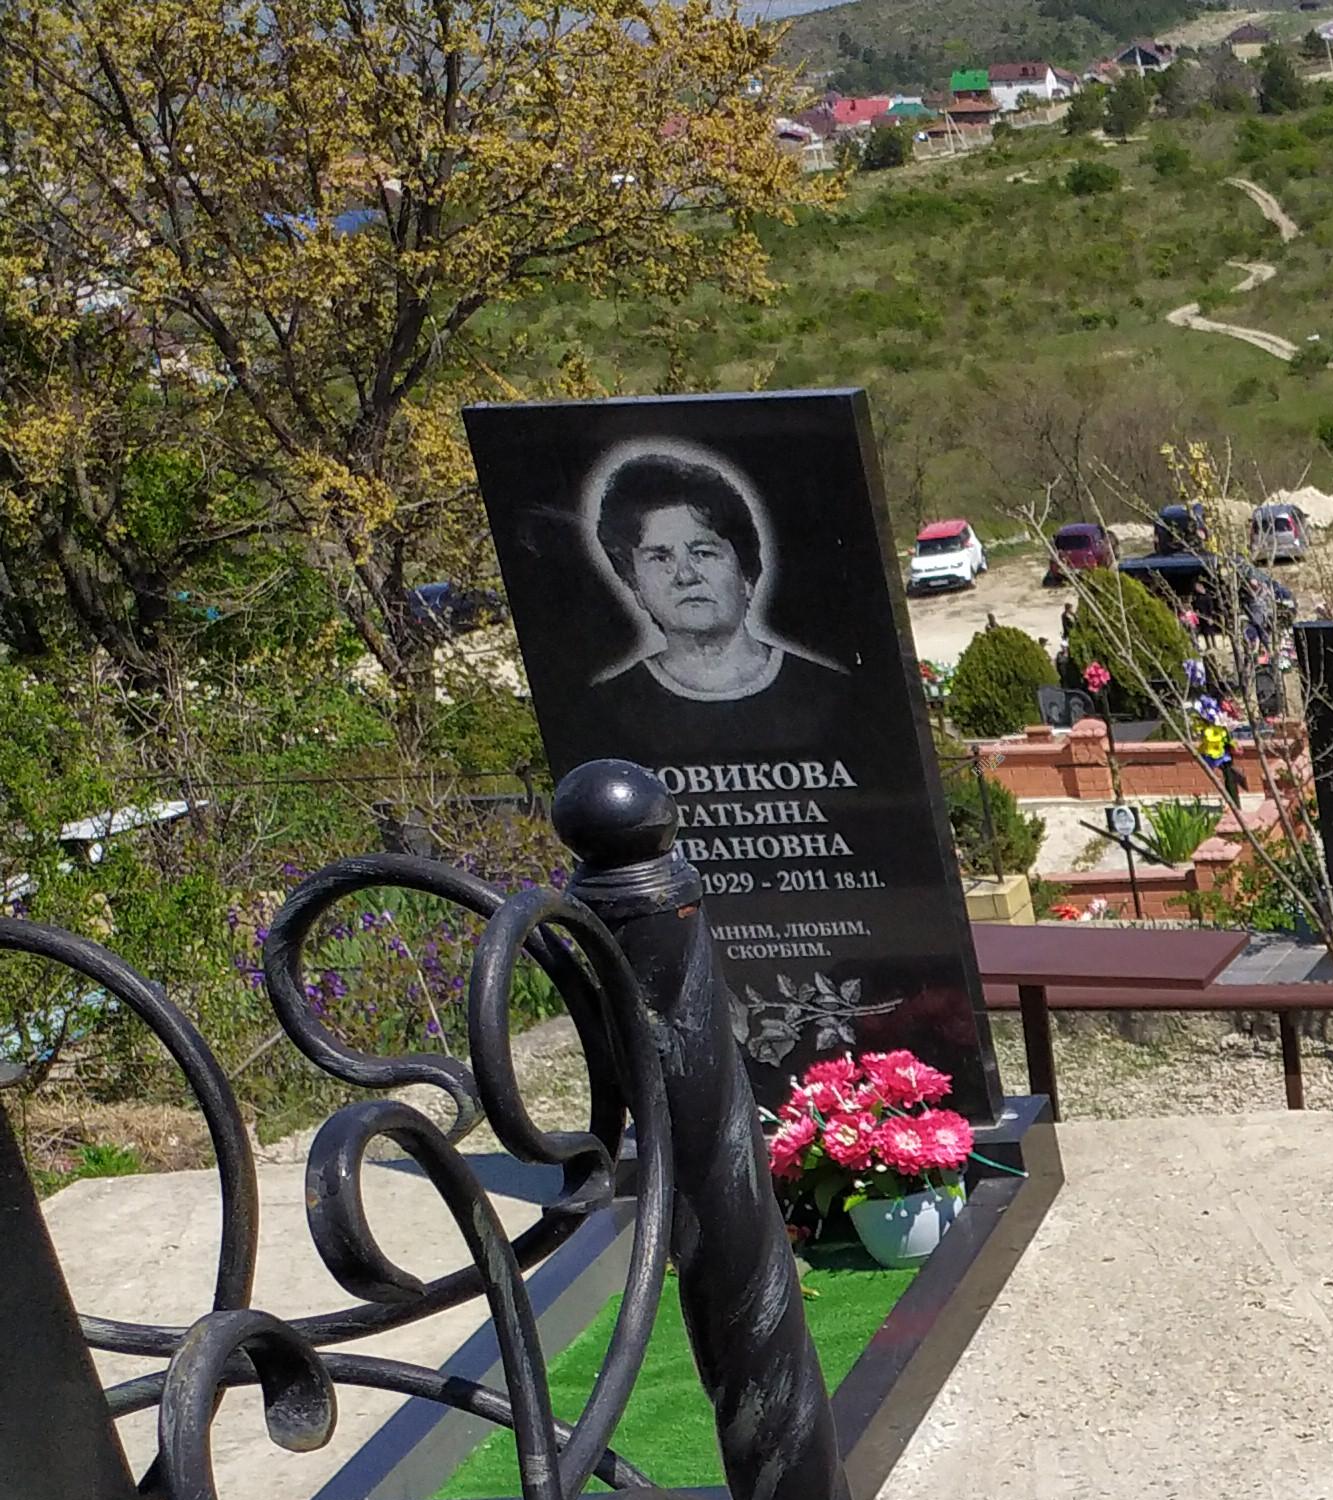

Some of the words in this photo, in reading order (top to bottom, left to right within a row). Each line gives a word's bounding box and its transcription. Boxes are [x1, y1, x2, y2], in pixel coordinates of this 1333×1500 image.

[656, 760, 857, 795] ОВИКОВА
[701, 871, 755, 895] 1929
[776, 868, 830, 892] 2011
[833, 870, 886, 890] 18.11.
[726, 941, 832, 960] СКОРБИМ.
